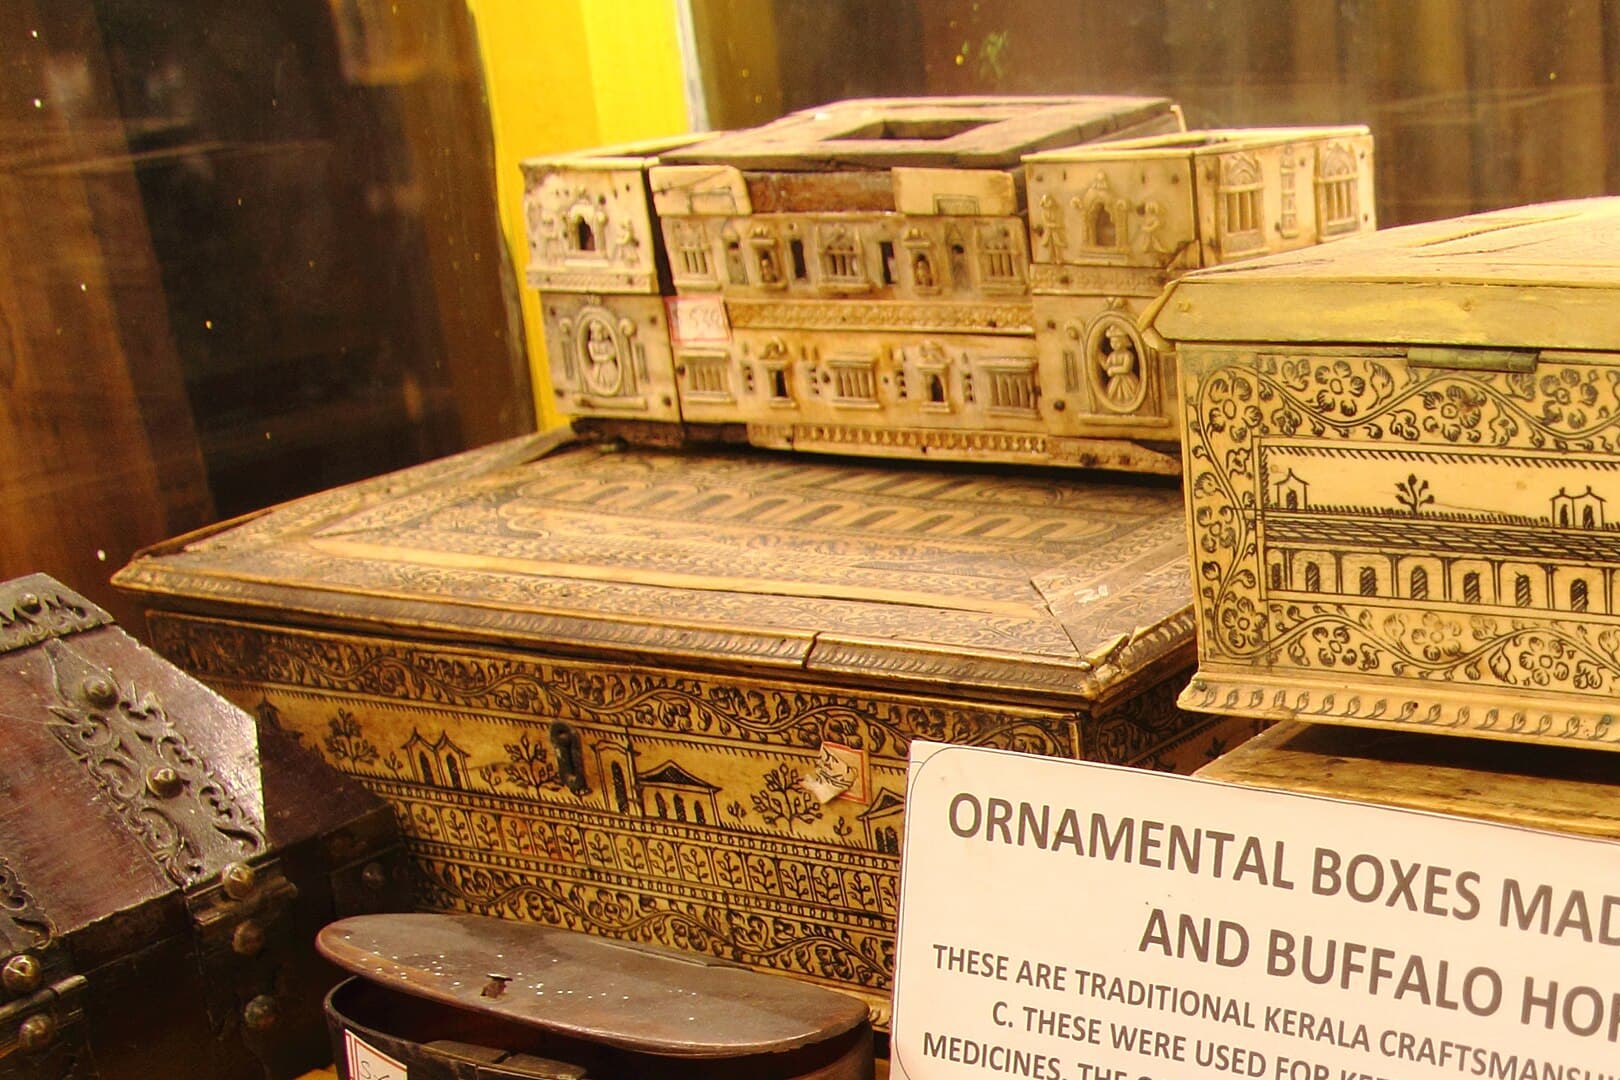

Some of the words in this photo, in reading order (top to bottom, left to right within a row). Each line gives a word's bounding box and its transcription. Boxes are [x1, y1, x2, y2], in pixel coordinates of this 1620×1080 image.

[947, 791, 1295, 891] ORNAMENTAL
[1310, 846, 1482, 922] BOXES
[931, 942, 1010, 982] THESE
[1014, 959, 1068, 993] ARE
[1073, 968, 1257, 1030] TRADITIONAL
[1263, 1005, 1371, 1054] KERALA
[1137, 907, 1251, 969] AND
[1265, 928, 1504, 1018] BUFFALO
[991, 1000, 1014, 1029] C.
[1021, 1005, 1103, 1046] THESE
[1109, 1022, 1188, 1063] WERE
[1194, 1038, 1268, 1079] USED
